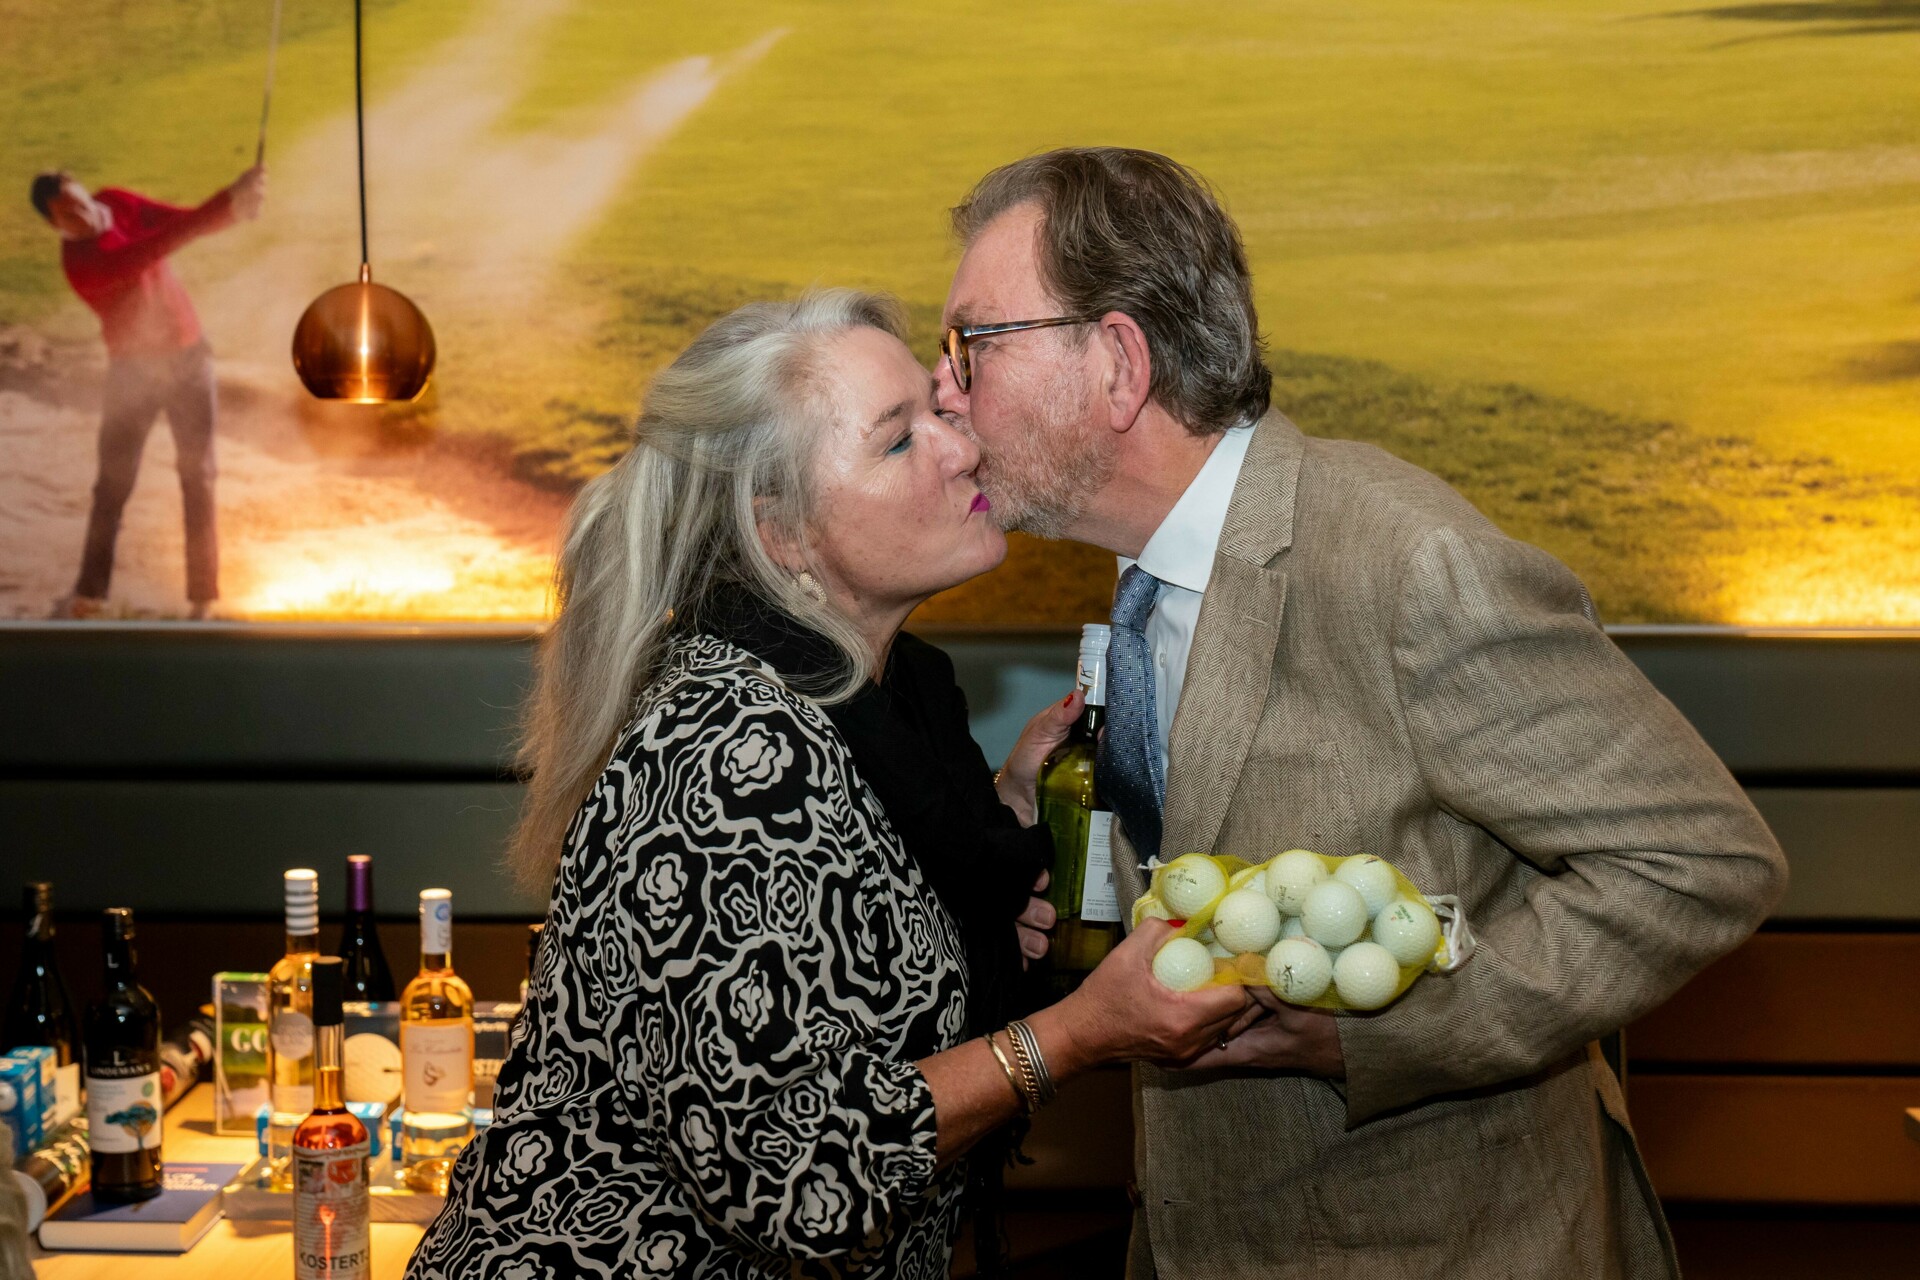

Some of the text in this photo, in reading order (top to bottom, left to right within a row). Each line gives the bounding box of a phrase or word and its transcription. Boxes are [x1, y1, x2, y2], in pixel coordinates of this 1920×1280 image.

[107, 952, 119, 968] L
[113, 1050, 126, 1067] L
[299, 1248, 369, 1270] KOSTERT
